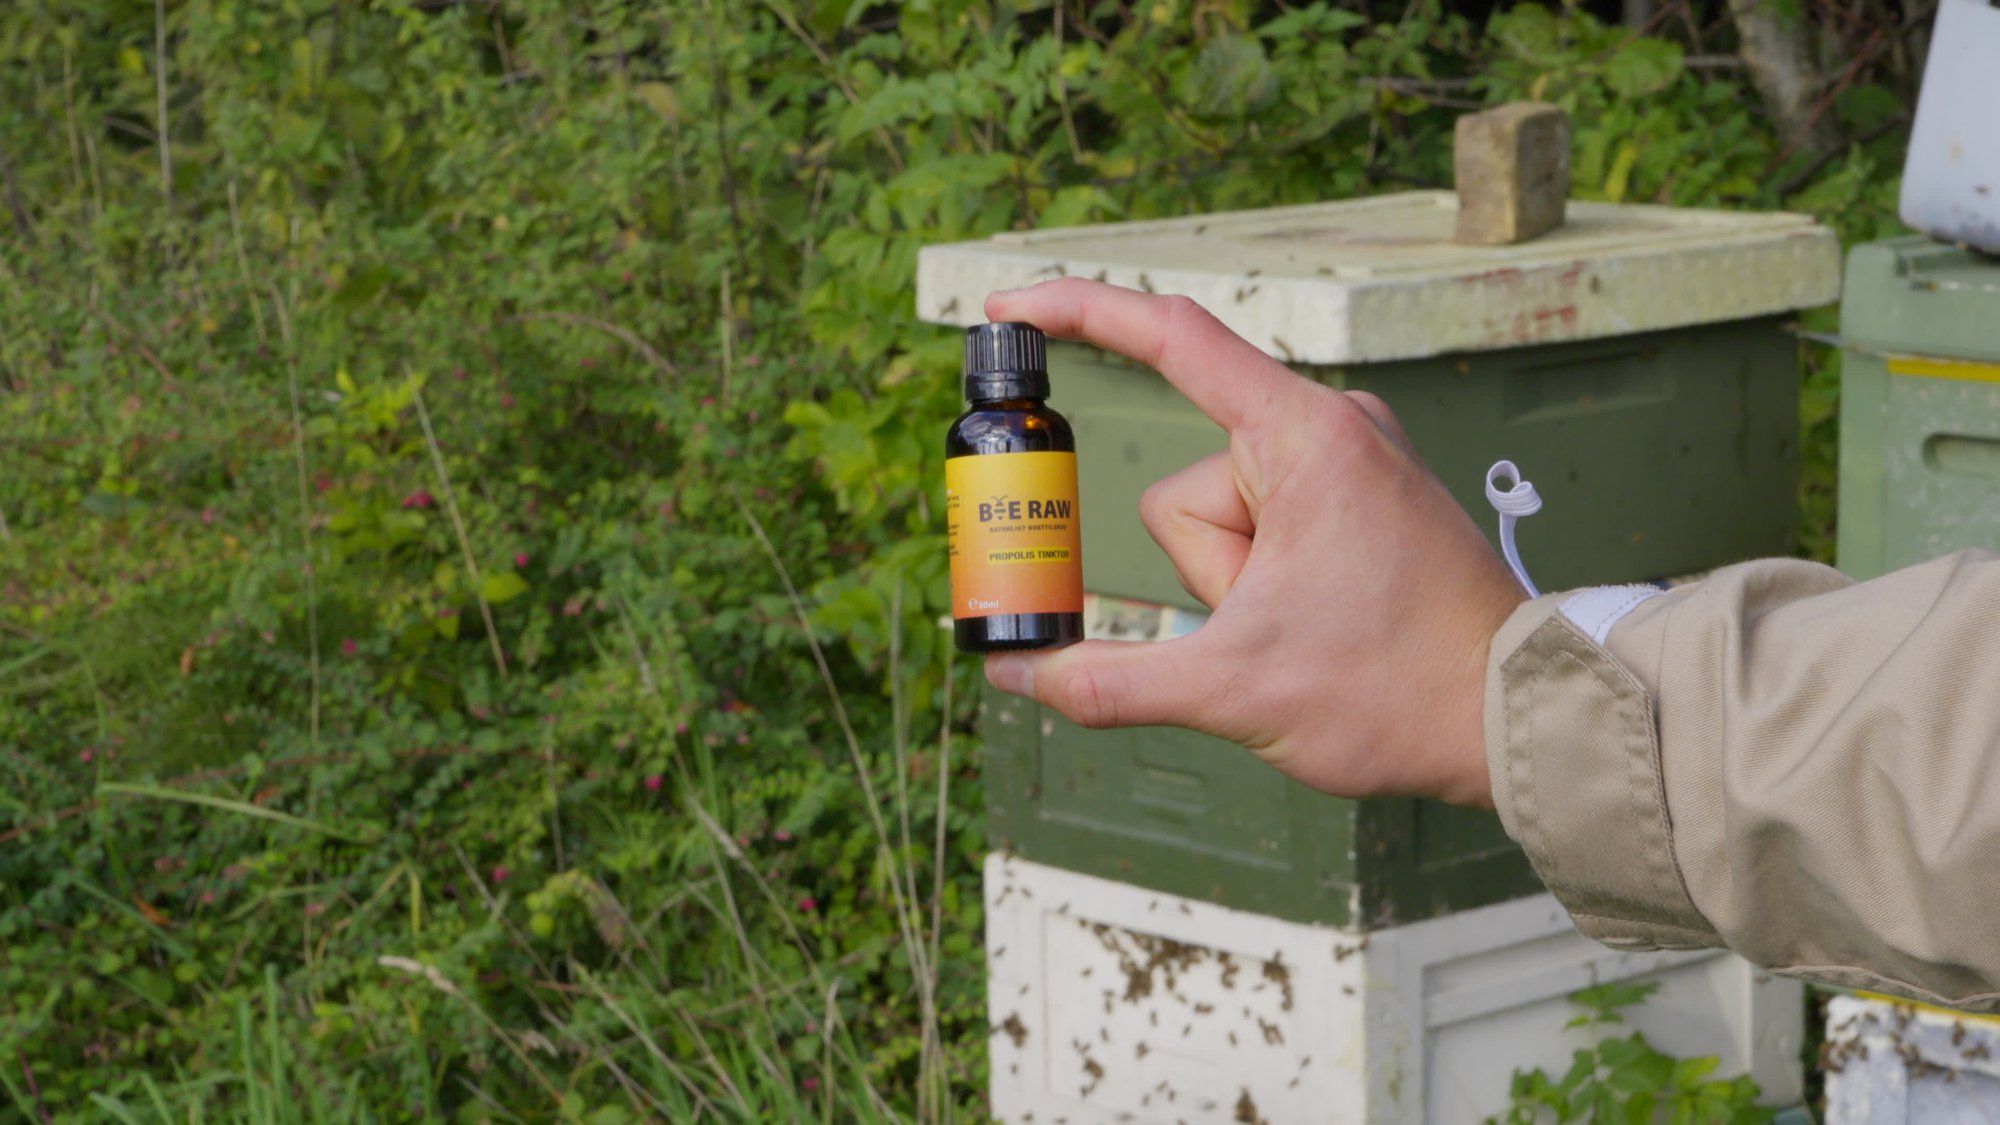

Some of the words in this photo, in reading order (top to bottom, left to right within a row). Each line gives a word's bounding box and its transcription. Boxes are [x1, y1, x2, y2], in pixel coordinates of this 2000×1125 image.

[1028, 500, 1071, 519] RAW
[989, 550, 1034, 561] PROPOLIS
[1037, 550, 1069, 559] TINKTUR
